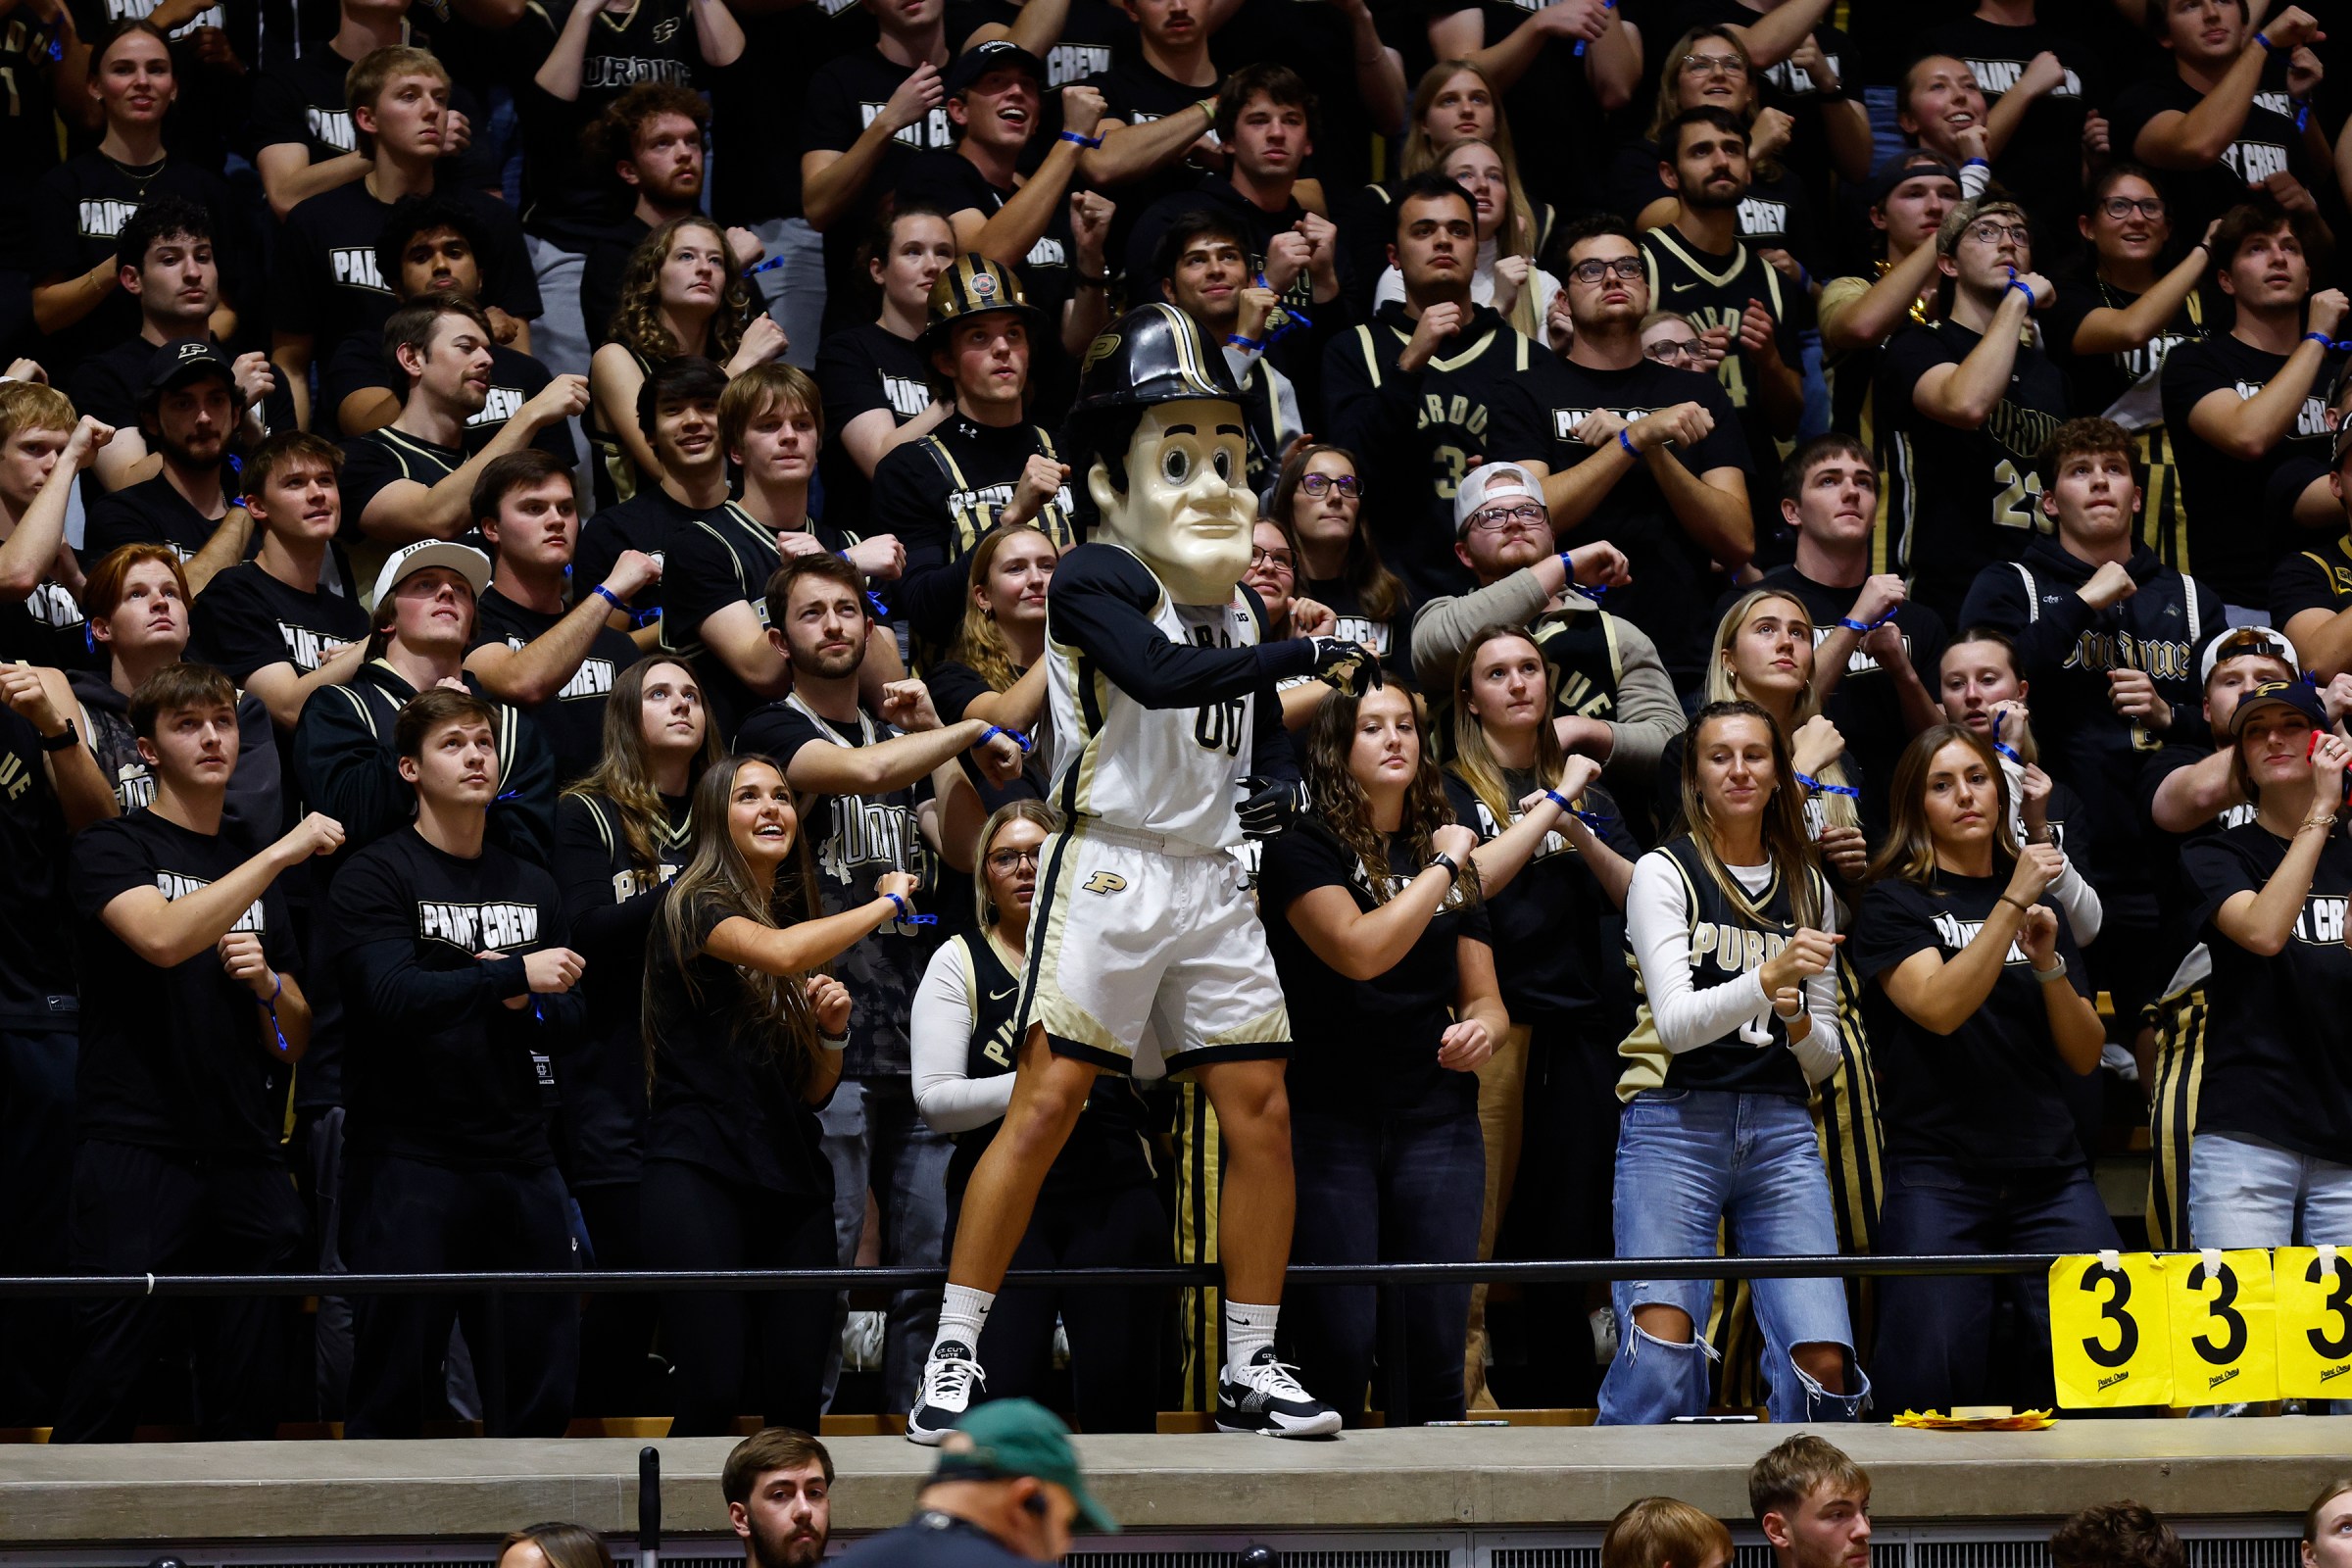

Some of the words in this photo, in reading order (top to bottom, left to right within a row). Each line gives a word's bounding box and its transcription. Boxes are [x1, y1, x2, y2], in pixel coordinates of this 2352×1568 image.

[1046, 45, 1110, 87] CREW
[2242, 143, 2287, 184] CREW
[178, 343, 209, 360] P
[1083, 333, 1122, 373] P
[1334, 618, 1390, 654] REW
[1195, 699, 1246, 758] 00
[1082, 870, 1128, 896] P
[422, 904, 479, 953] PAINT
[479, 904, 539, 951] CREW
[1689, 920, 1793, 974] PURD
[2080, 1260, 2138, 1367] 3
[2186, 1260, 2247, 1365] 3
[2304, 1254, 2352, 1360] 3
[2097, 1375, 2113, 1388] Paint
[2208, 1373, 2224, 1385] Paint
[2320, 1368, 2335, 1379] Paint
